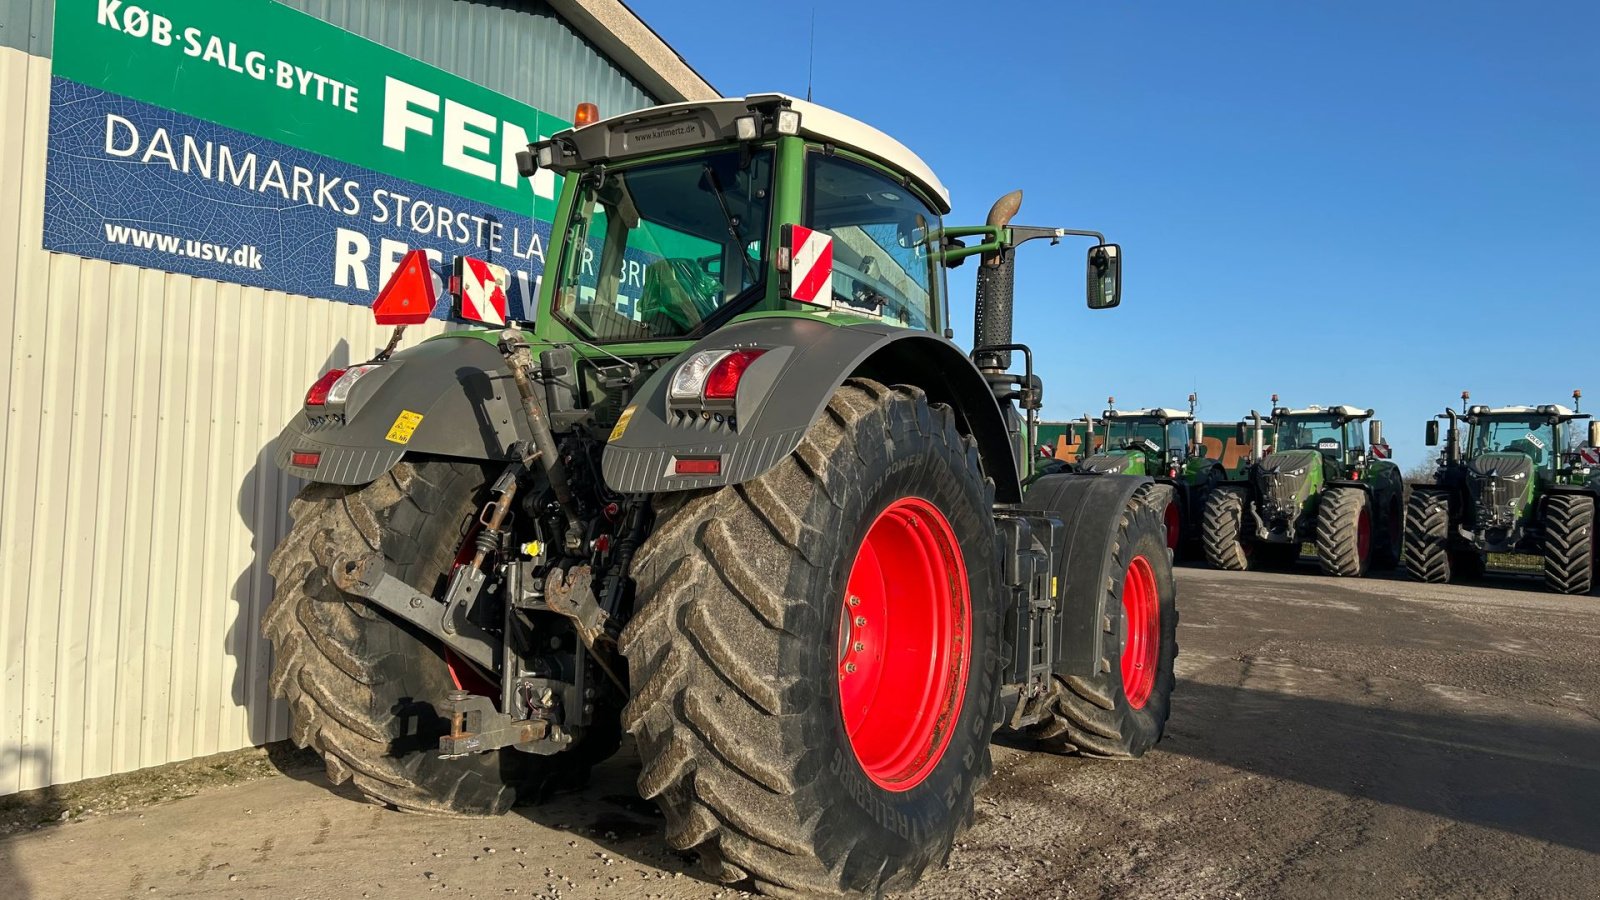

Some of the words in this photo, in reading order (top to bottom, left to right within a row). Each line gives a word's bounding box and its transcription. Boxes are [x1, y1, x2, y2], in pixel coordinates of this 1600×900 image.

[382, 75, 557, 201] FEN
[105, 113, 360, 216] DANMARKS
[372, 188, 503, 253] STØRSTE
[104, 223, 263, 271] www.usv.dk
[885, 453, 925, 481] POWER
